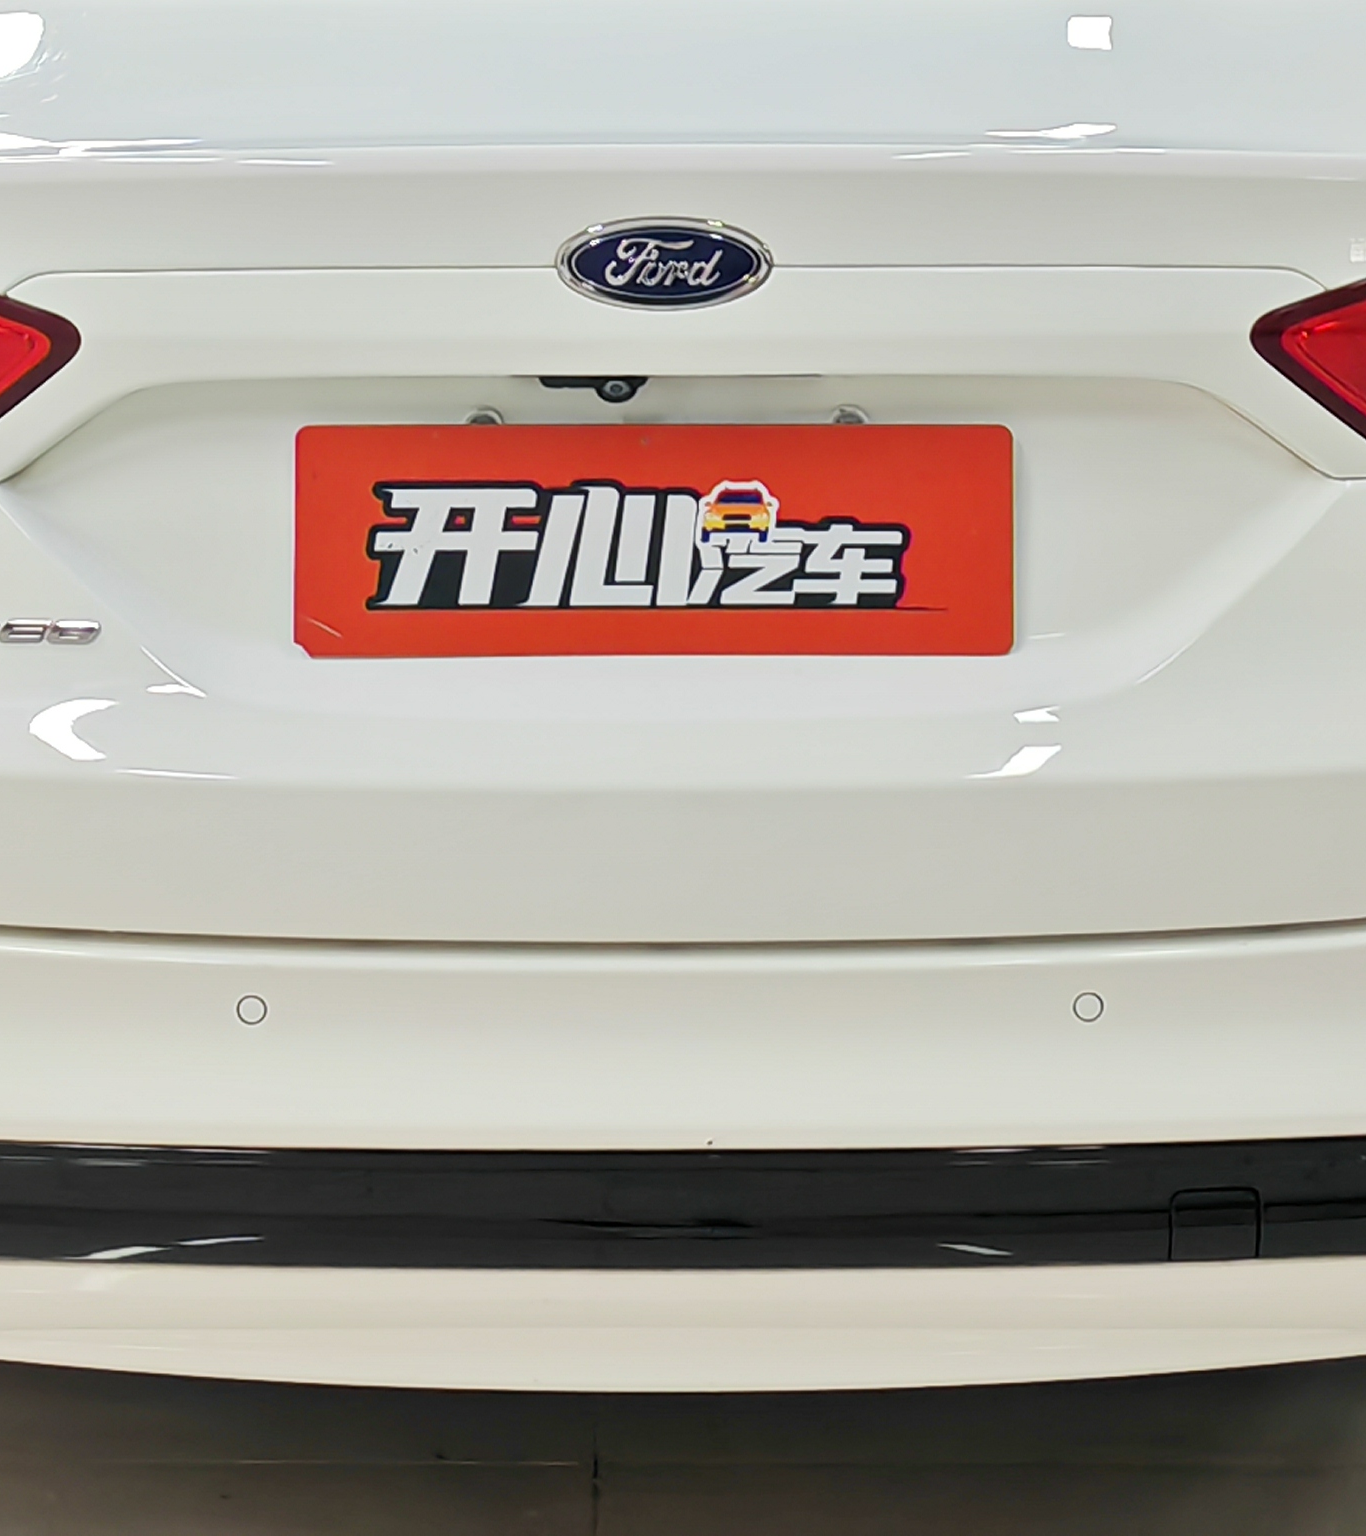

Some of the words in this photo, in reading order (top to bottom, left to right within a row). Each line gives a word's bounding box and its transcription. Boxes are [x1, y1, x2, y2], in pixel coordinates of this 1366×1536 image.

[605, 236, 722, 290] Ford
[370, 482, 909, 610] 开心汽车
